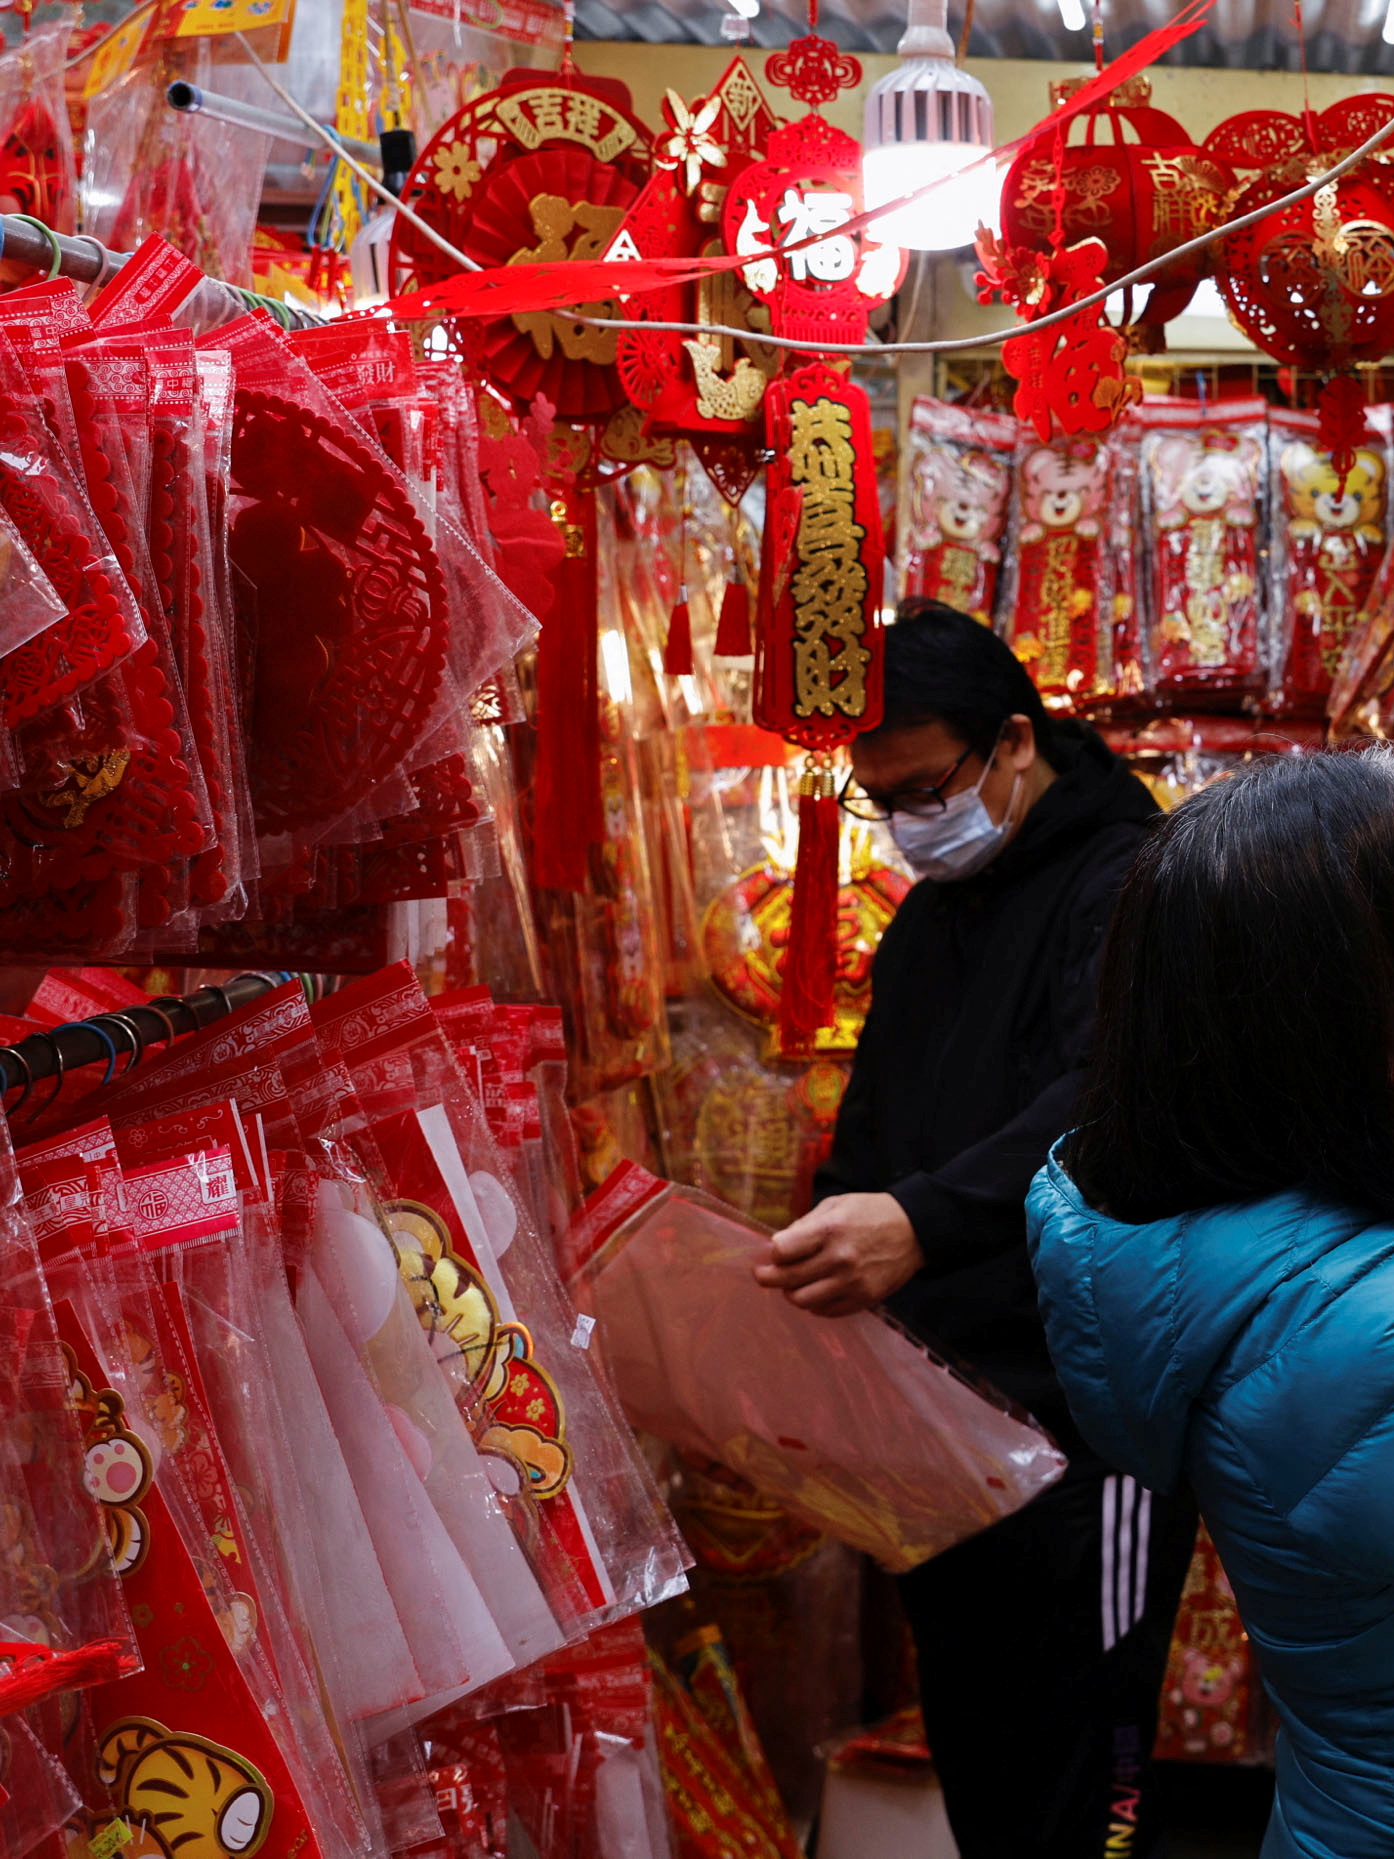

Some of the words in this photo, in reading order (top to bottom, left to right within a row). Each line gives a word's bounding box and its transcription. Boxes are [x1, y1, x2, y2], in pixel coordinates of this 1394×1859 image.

[777, 188, 855, 281] 福
[790, 397, 871, 718] 恭喜發財
[139, 1190, 169, 1220] 福
